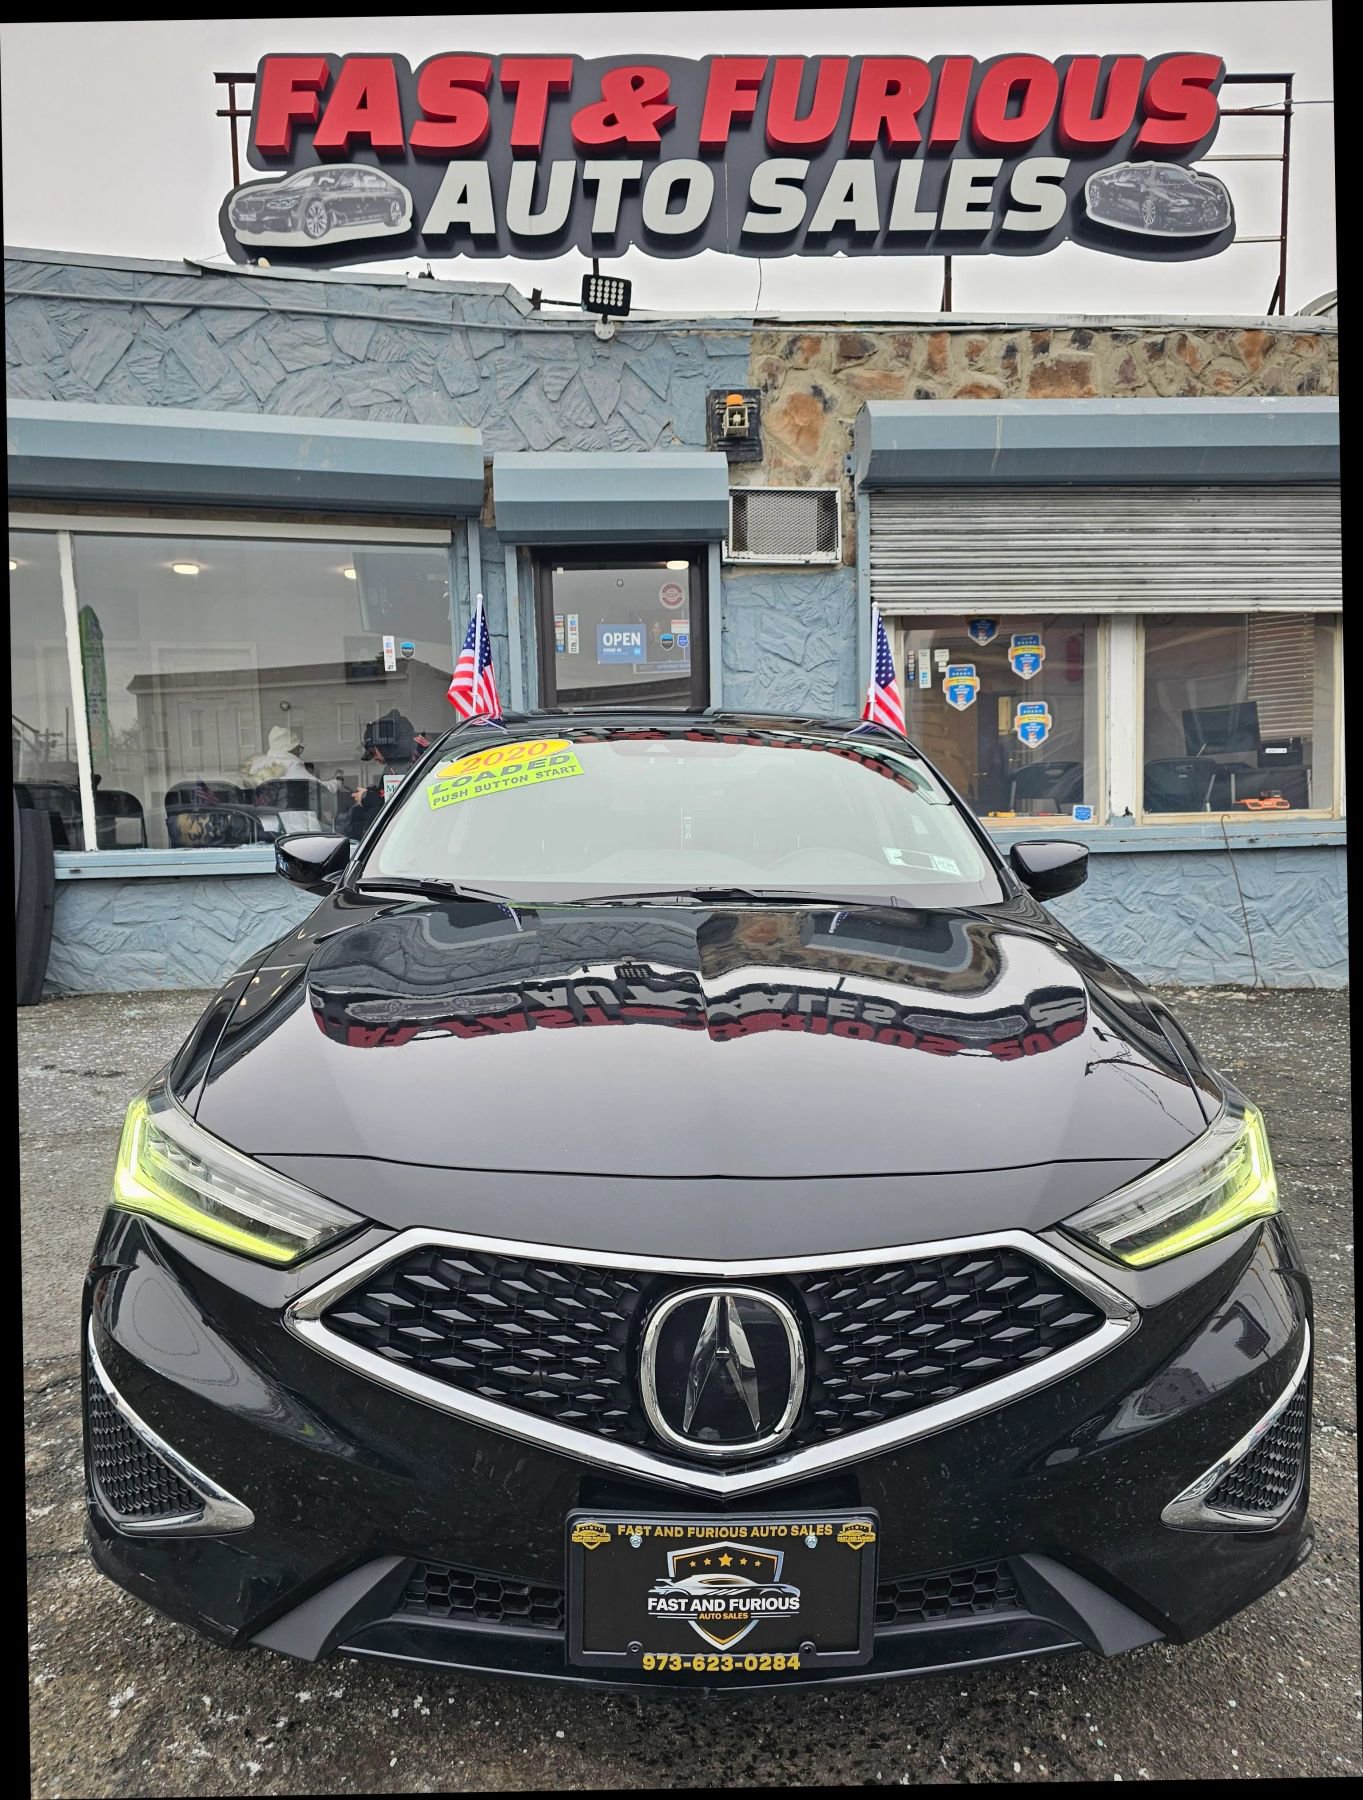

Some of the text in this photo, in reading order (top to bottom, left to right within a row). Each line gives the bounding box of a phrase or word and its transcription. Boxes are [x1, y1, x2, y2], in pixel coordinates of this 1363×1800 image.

[255, 54, 1223, 157] FAST & FURIOUS
[421, 157, 1070, 236] AUTO SALES
[602, 632, 641, 646] OPEN
[460, 742, 548, 773] 2020
[432, 754, 571, 796] LOADED
[433, 764, 577, 806] PUSH BUTTON START
[617, 1524, 833, 1538] FAST AND FURIOUS AUTO SALES
[648, 1597, 800, 1612] FAST AND FURIOUS
[722, 1612, 749, 1620] SALES
[642, 1653, 801, 1672] 973-623-0284
